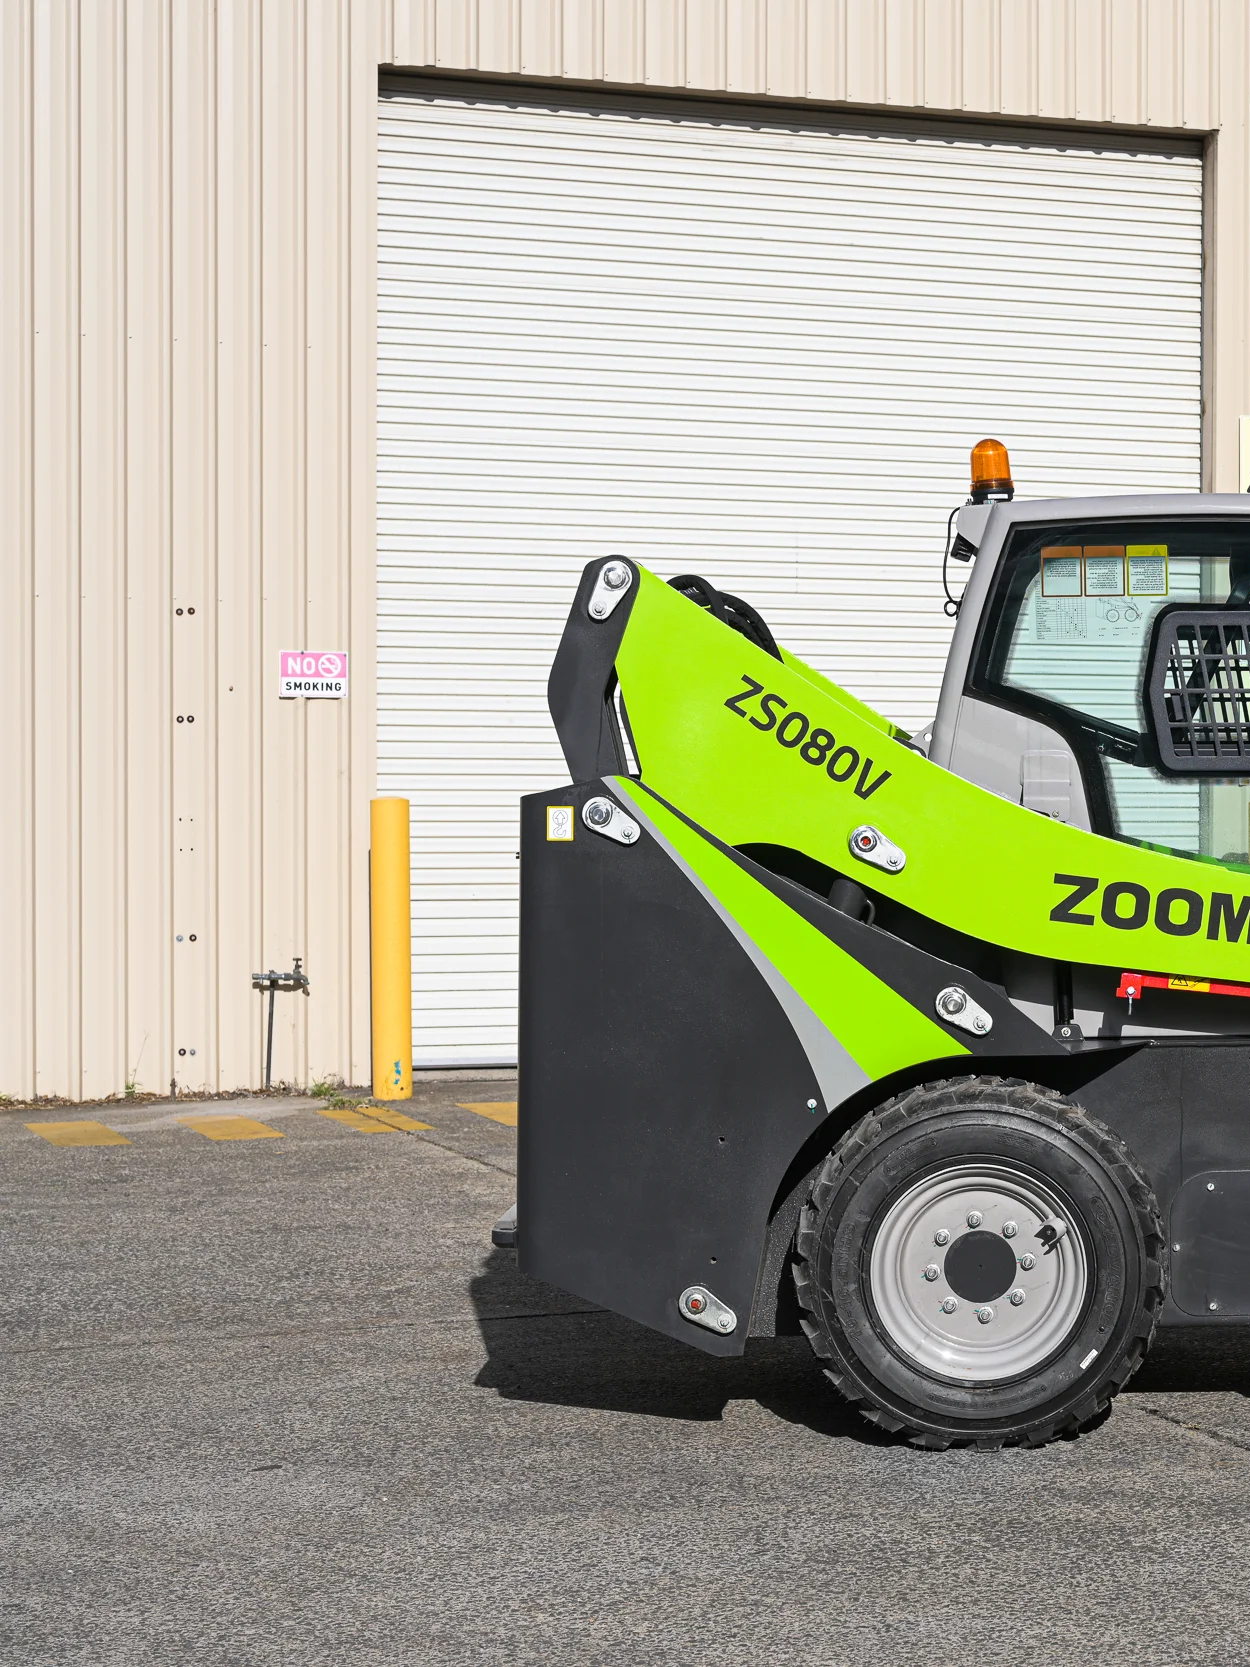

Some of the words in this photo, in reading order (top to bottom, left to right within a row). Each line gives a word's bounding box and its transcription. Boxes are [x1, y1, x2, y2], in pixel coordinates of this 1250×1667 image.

[287, 656, 316, 675] NO
[285, 681, 342, 692] SMOKING
[723, 674, 892, 801] ZS080V
